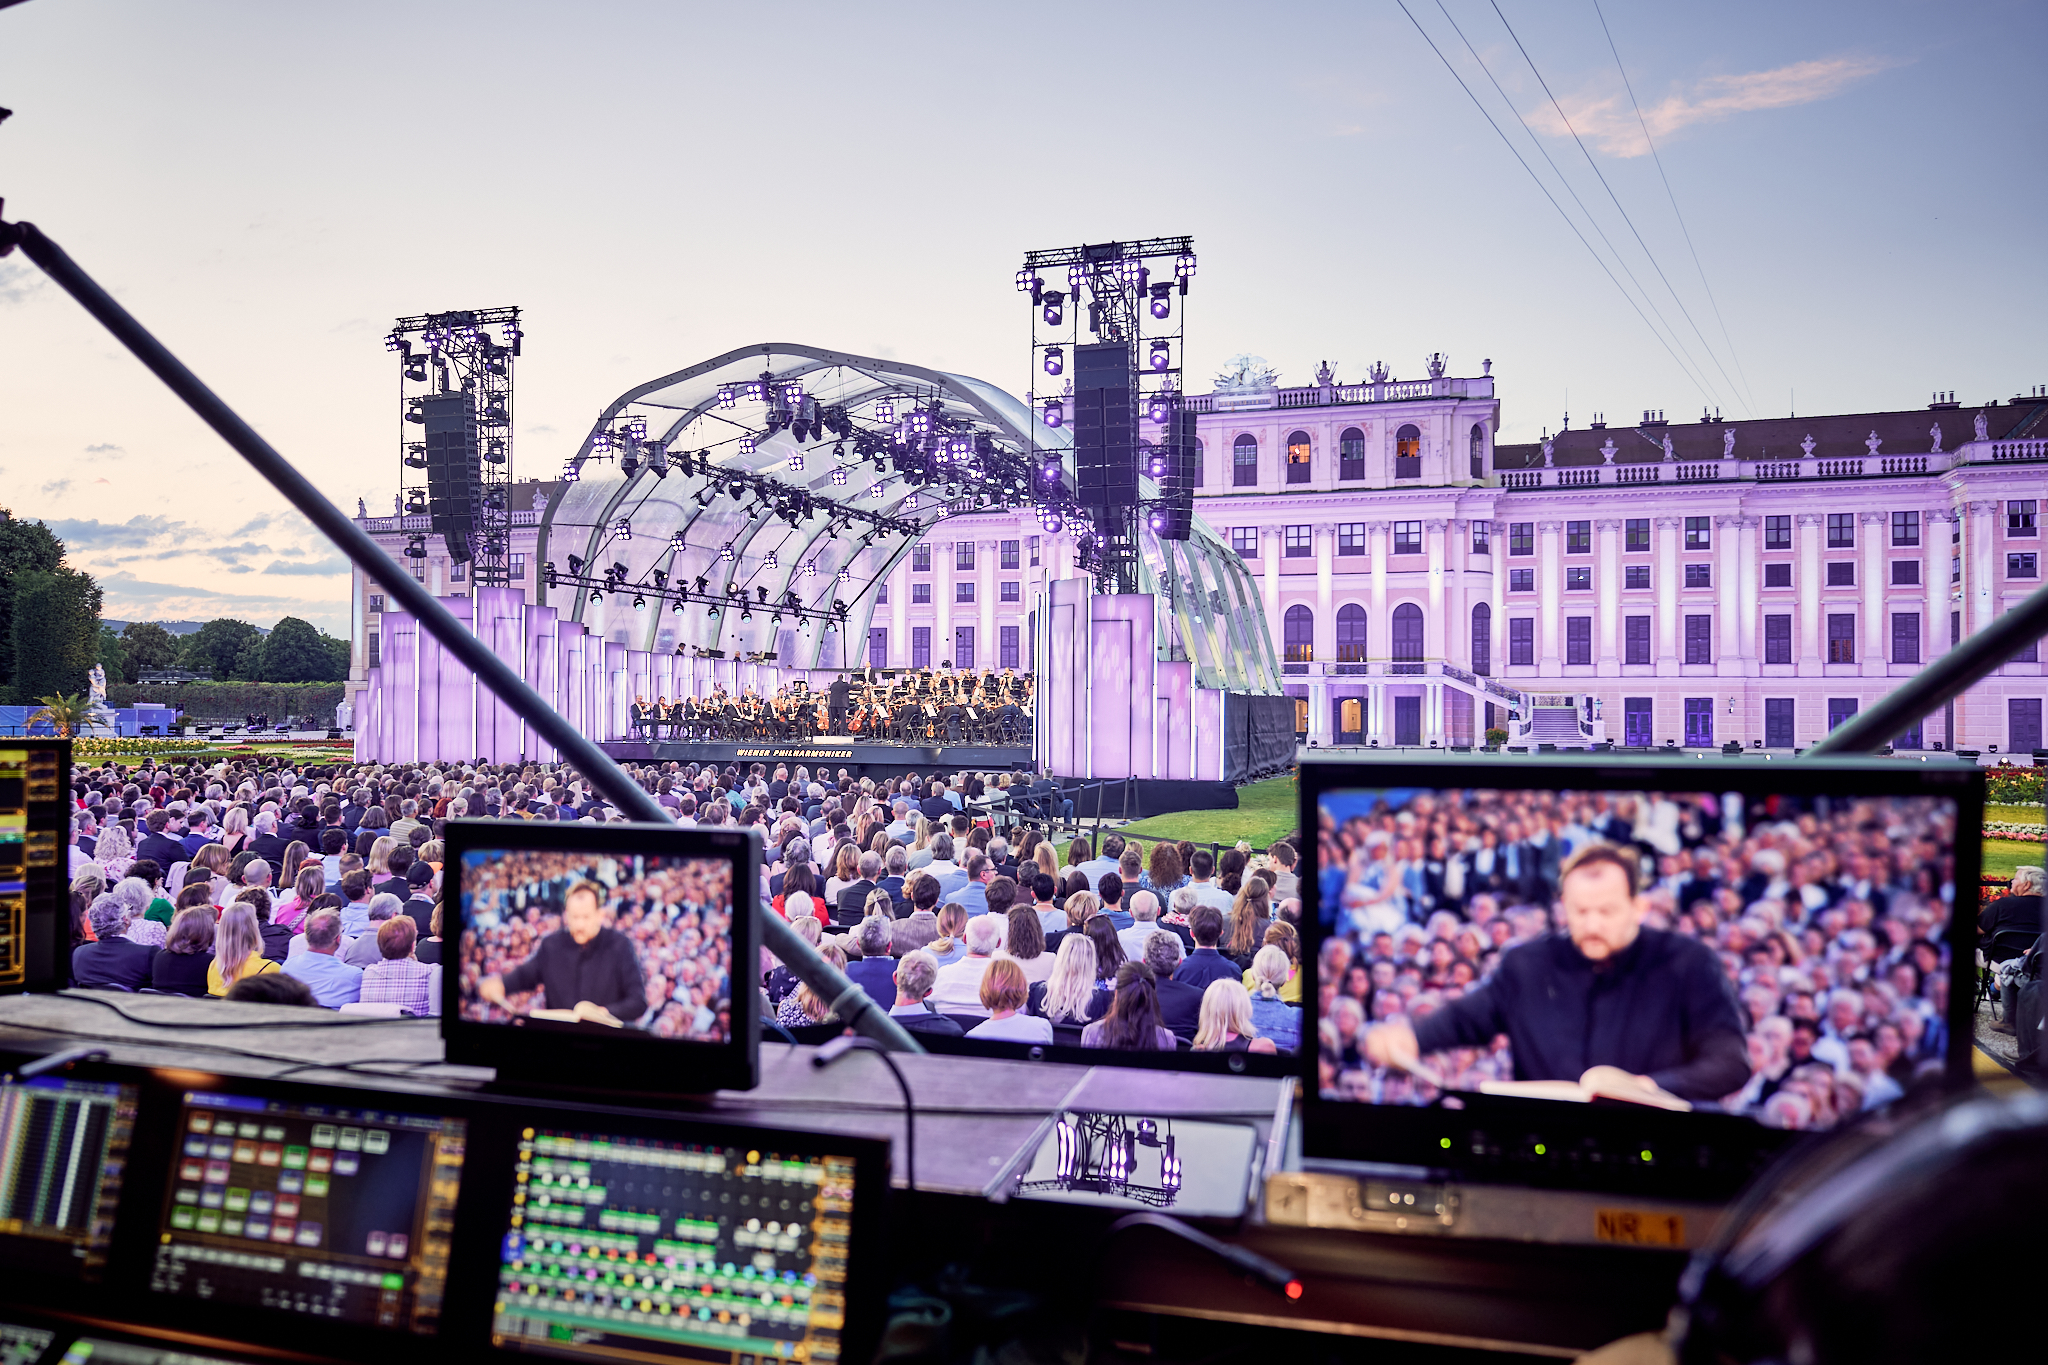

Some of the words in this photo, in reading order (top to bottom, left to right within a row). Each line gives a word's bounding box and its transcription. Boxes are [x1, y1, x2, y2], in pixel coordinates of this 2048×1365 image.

[736, 749, 771, 757] WIENER
[773, 749, 853, 758] PHILHARMONIKER
[1664, 1215, 1679, 1245] 1
